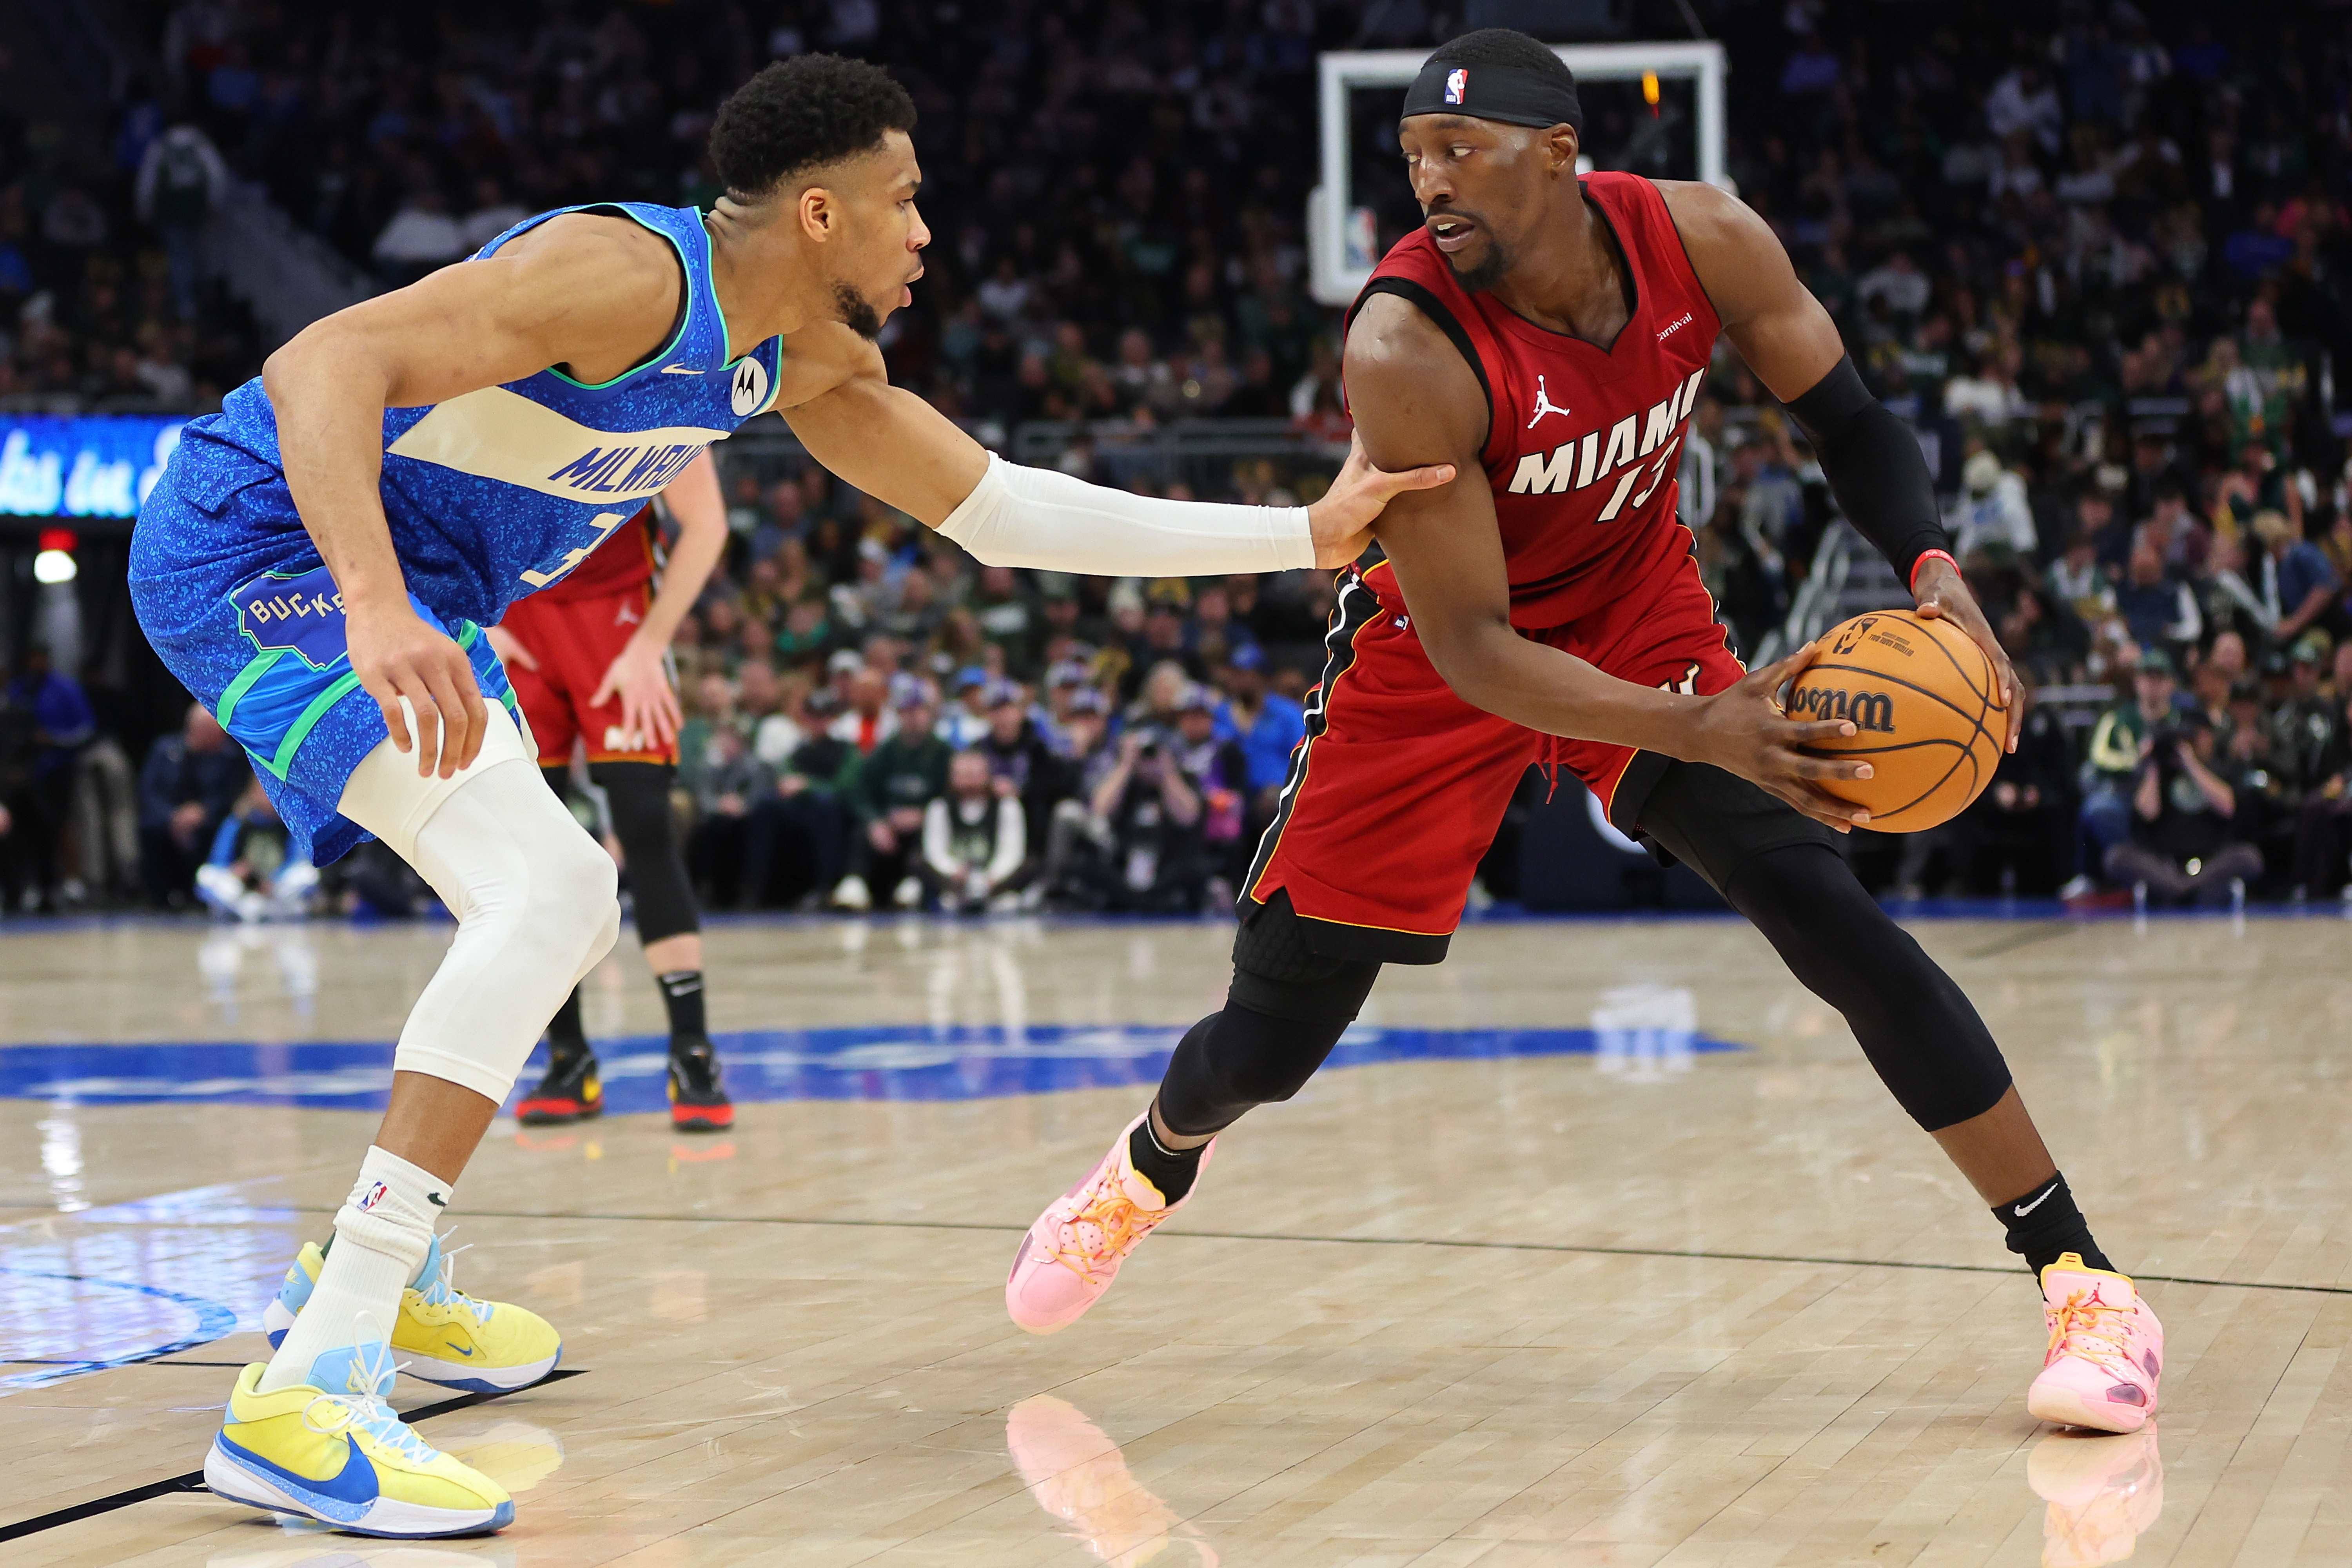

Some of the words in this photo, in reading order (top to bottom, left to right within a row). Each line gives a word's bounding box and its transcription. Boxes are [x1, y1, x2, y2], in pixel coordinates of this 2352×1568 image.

[1507, 367, 1705, 495] MIAMI
[1597, 436, 1680, 522] 13
[1791, 686, 1895, 734] Wilso
